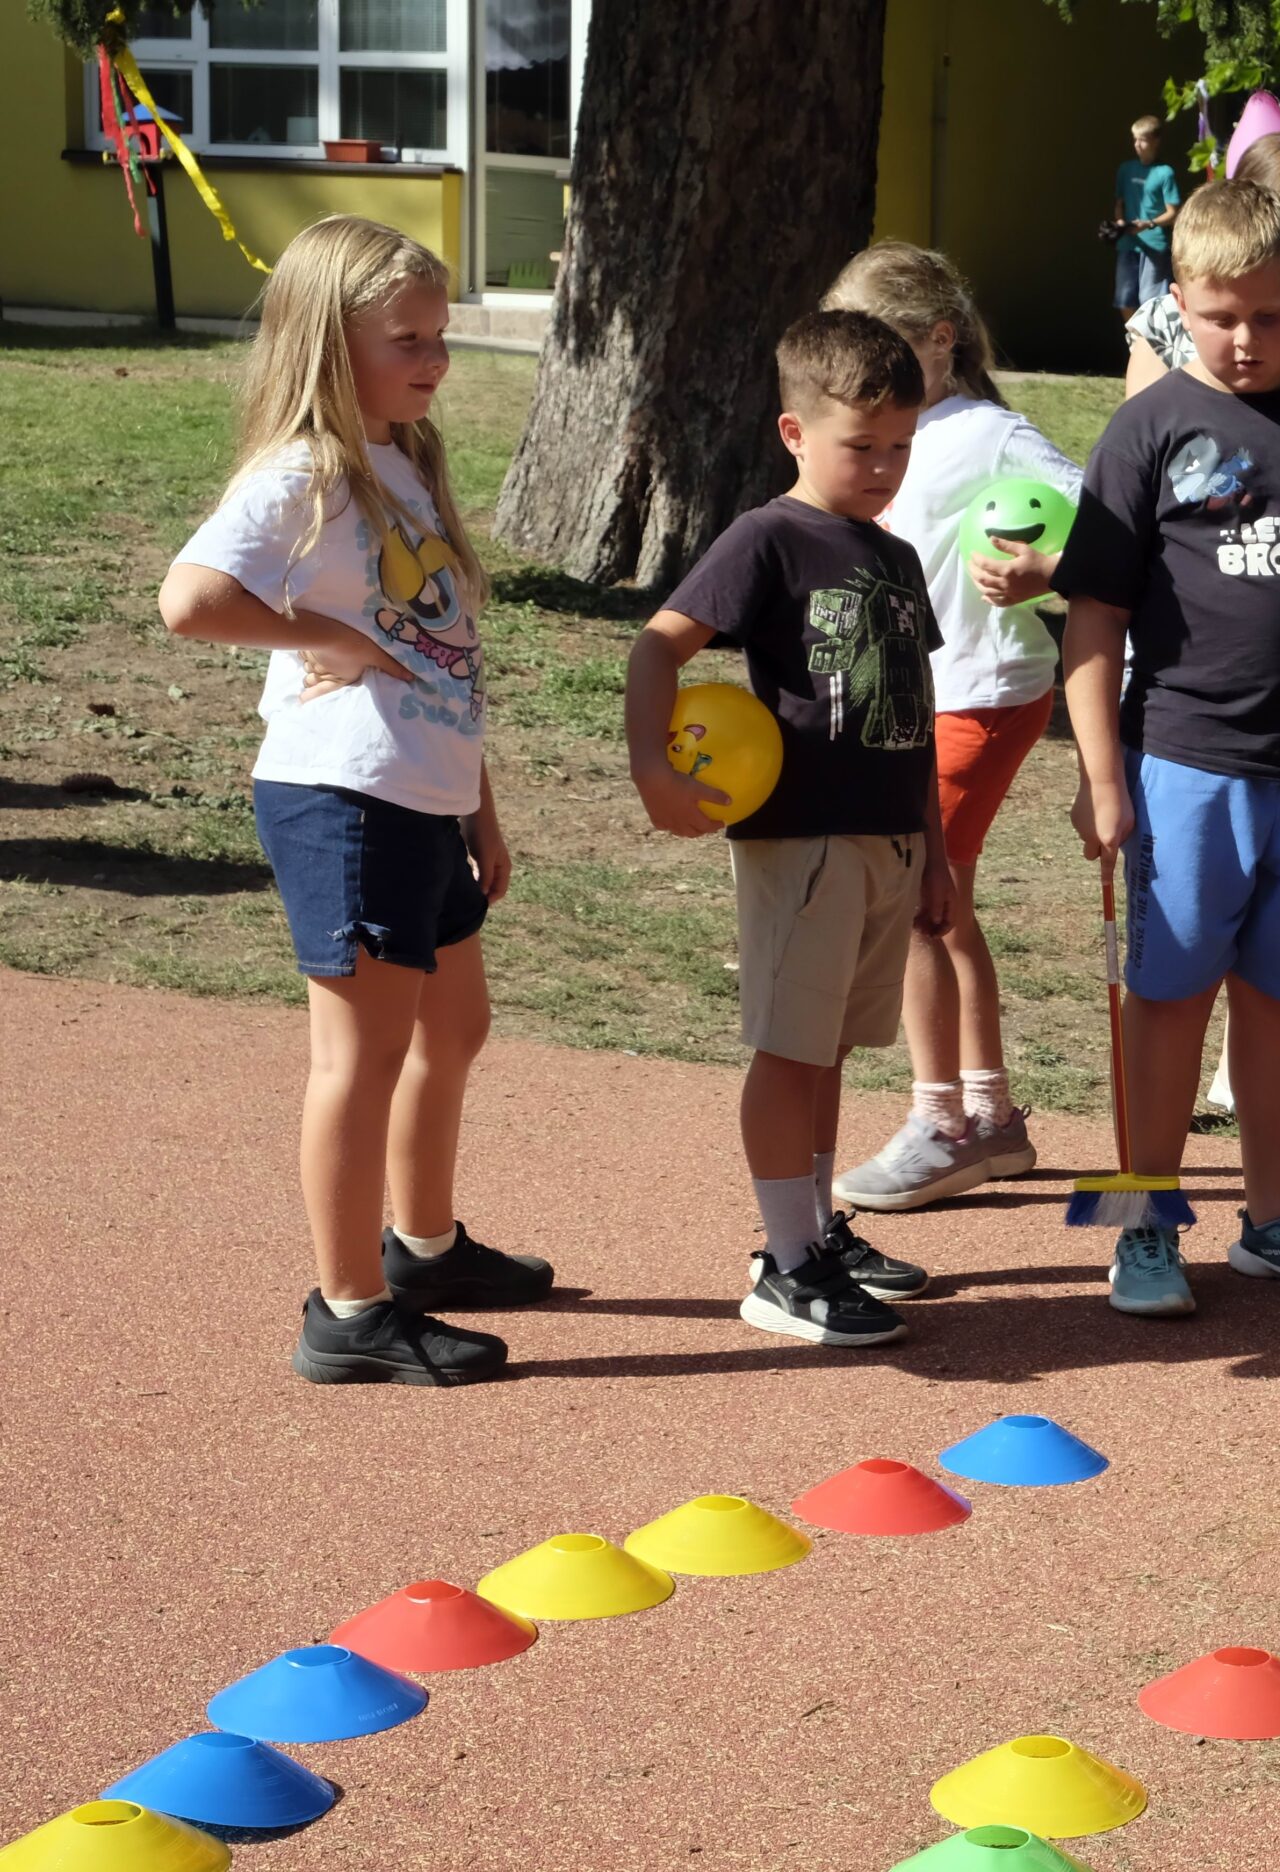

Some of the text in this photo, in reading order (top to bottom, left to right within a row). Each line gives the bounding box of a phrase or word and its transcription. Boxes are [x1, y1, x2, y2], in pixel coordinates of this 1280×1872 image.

[1134, 833, 1157, 969] CHASE THE HORIZON
